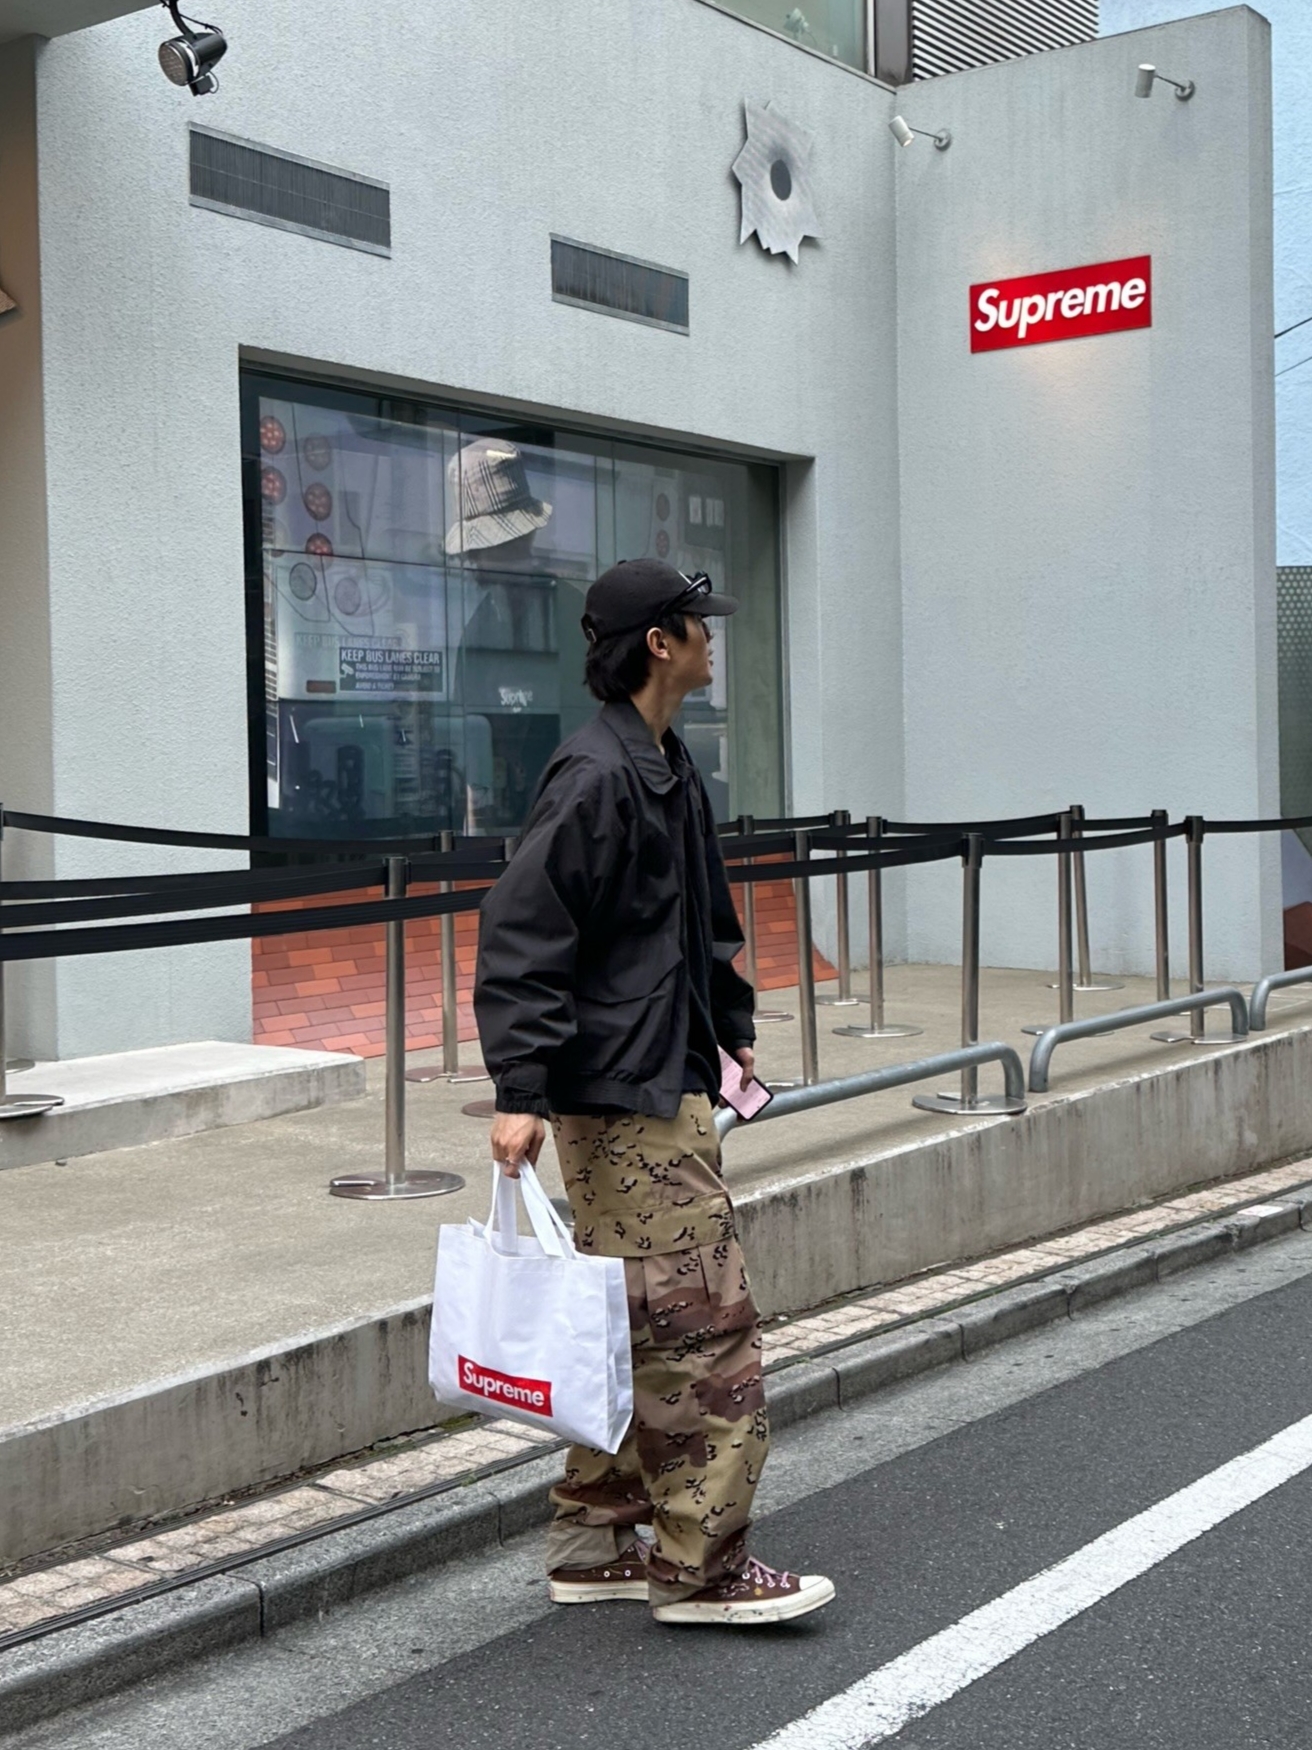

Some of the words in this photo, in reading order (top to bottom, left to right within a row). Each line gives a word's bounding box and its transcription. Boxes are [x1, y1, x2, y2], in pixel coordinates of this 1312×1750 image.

[974, 277, 1147, 339] Supreme
[341, 649, 364, 661] KEEP
[366, 650, 383, 662] BUS
[385, 651, 412, 664] LANES
[414, 652, 440, 664] CLEAR
[463, 1362, 545, 1406] Supreme
